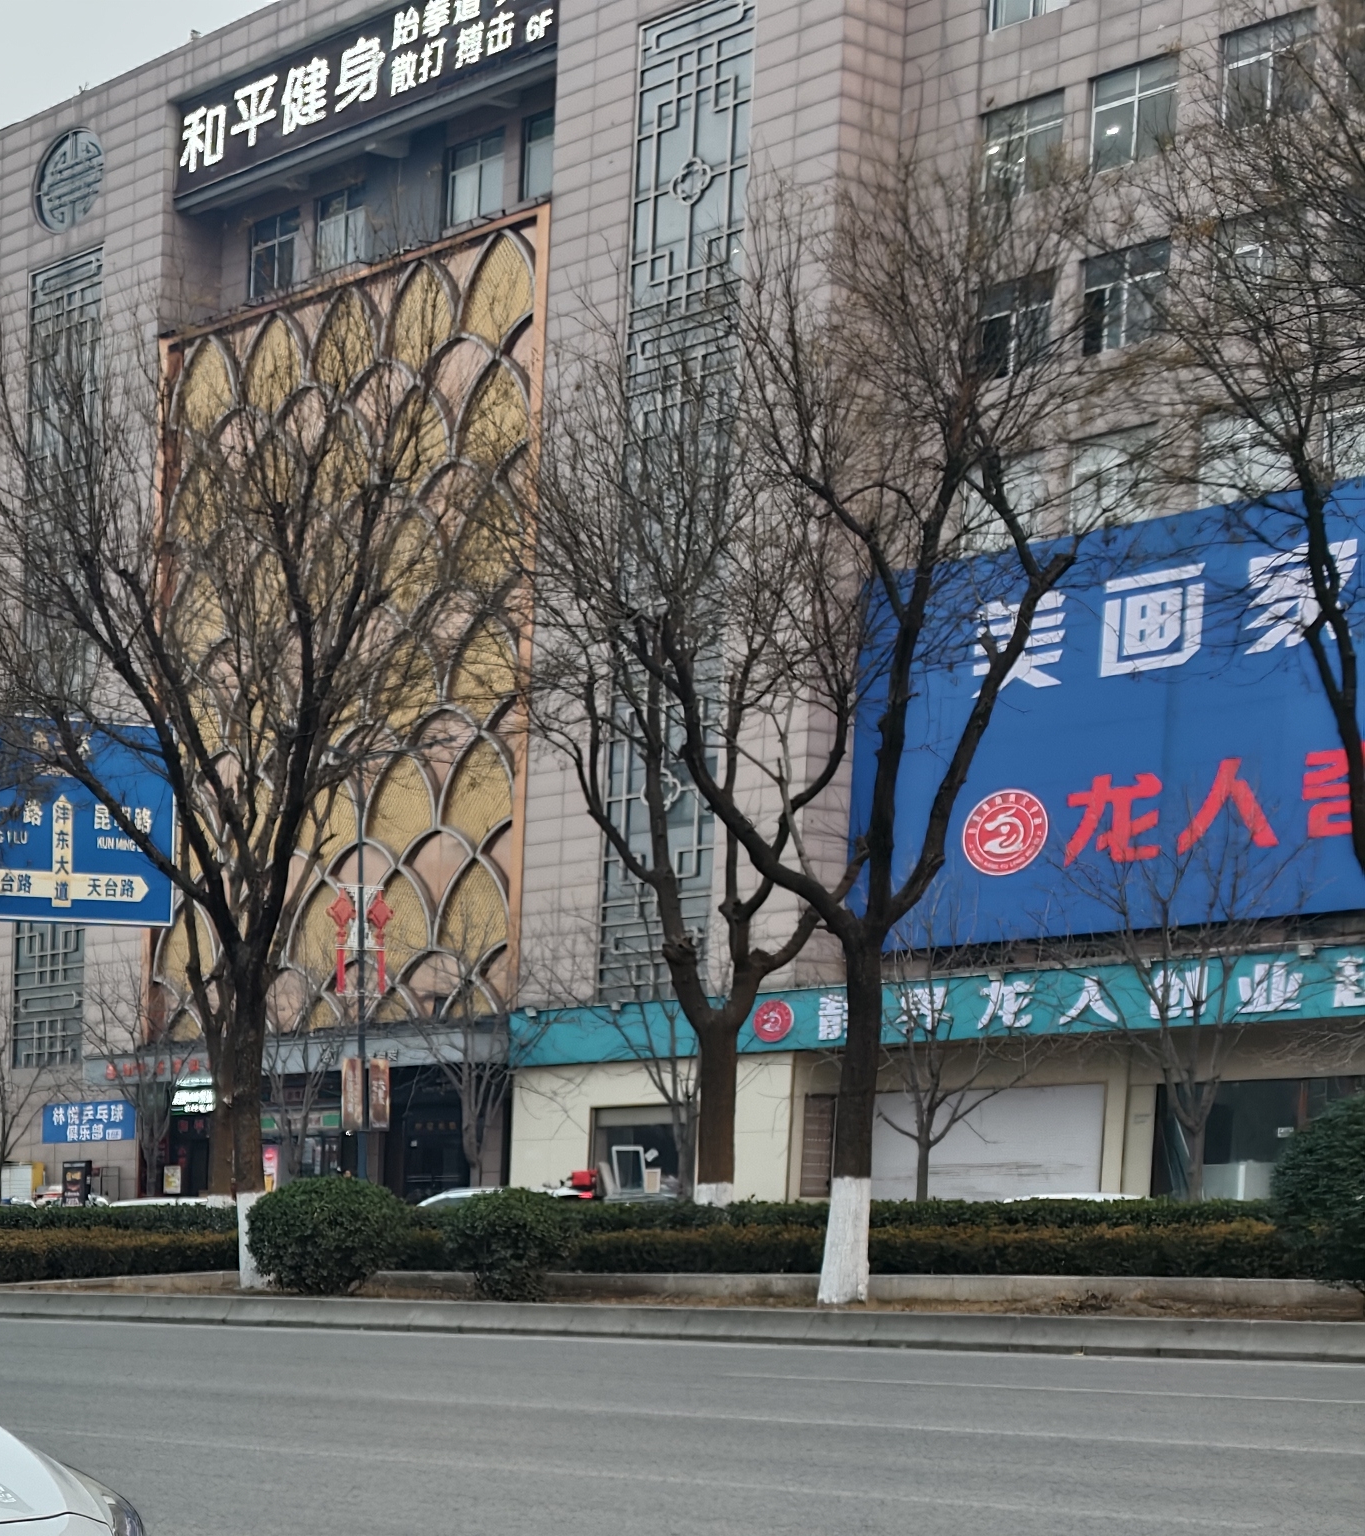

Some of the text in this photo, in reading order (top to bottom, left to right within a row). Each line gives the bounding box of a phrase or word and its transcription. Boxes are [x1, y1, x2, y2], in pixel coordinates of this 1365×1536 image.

[180, 37, 387, 173] 和平健身
[87, 877, 135, 899] 天台路
[66, 1123, 104, 1142] 俱乐部
